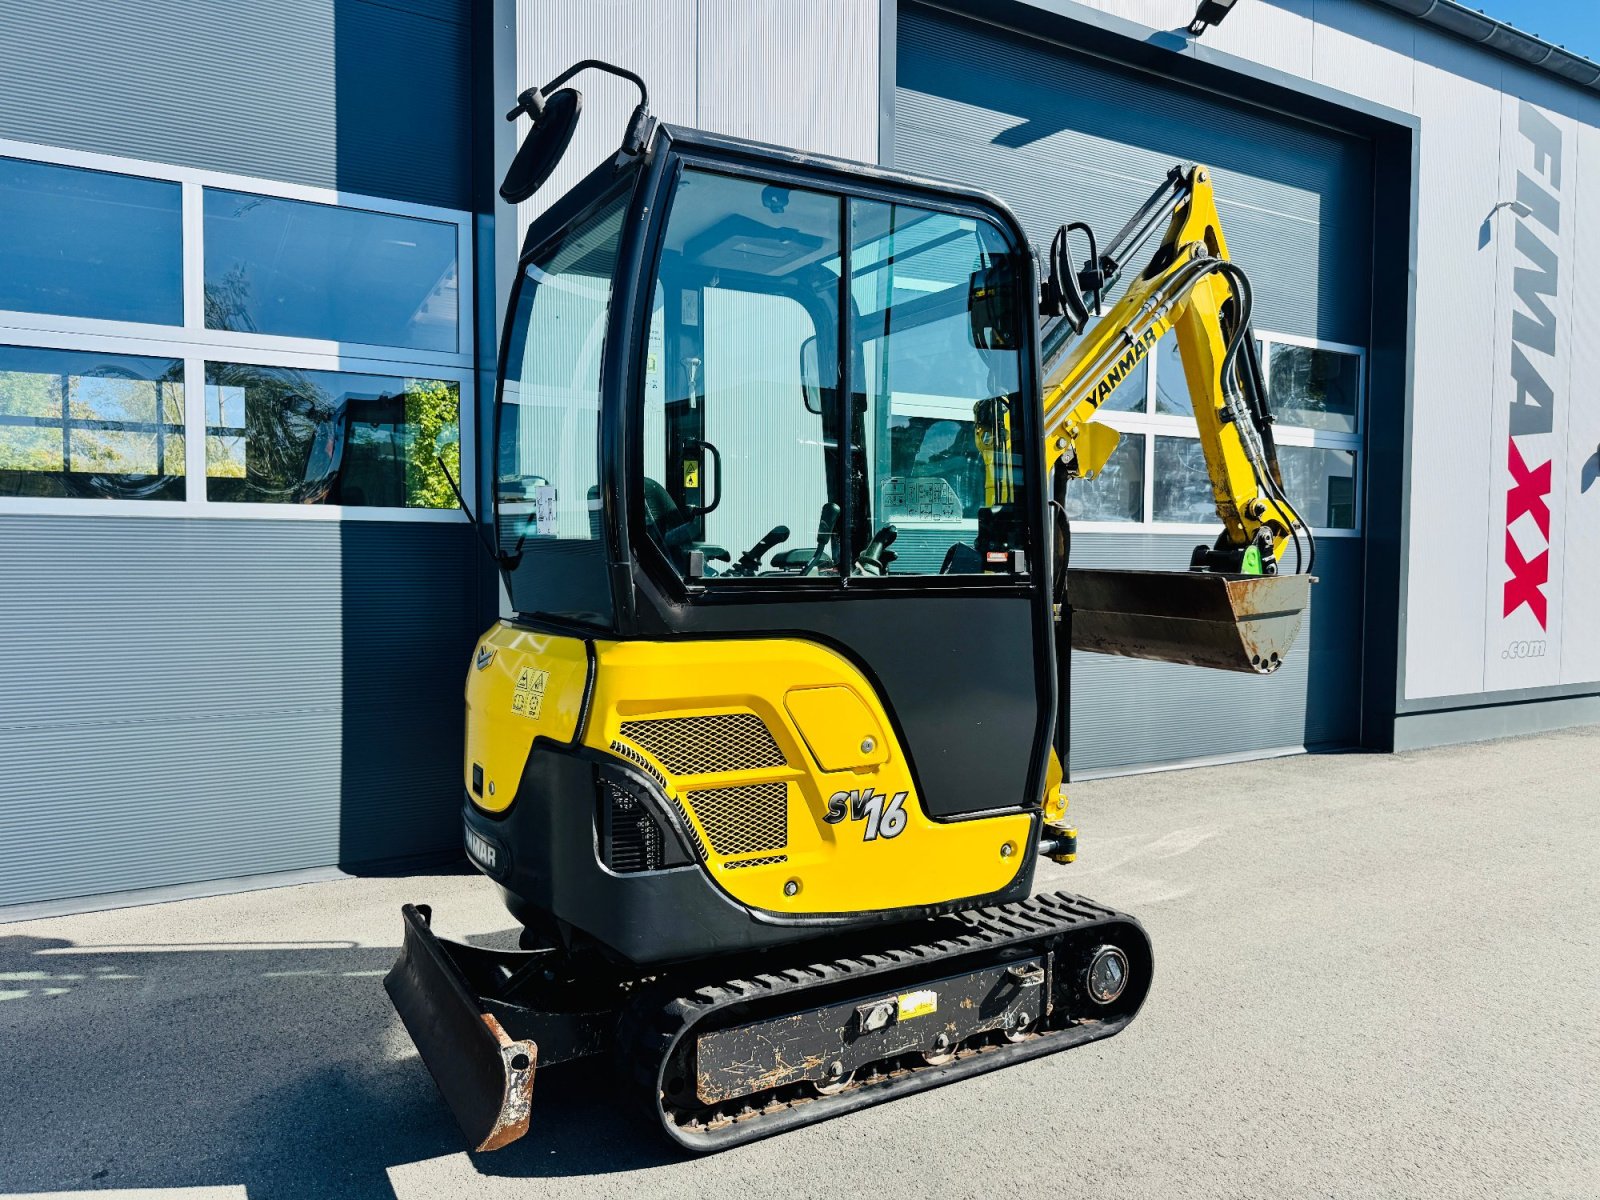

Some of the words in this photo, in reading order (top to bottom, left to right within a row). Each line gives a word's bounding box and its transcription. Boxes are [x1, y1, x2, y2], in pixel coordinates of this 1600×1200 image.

[1085, 327, 1158, 410] YANMAR
[1502, 96, 1562, 634] FIMAXX
[1501, 639, 1547, 659] .com
[822, 787, 909, 842] SV16
